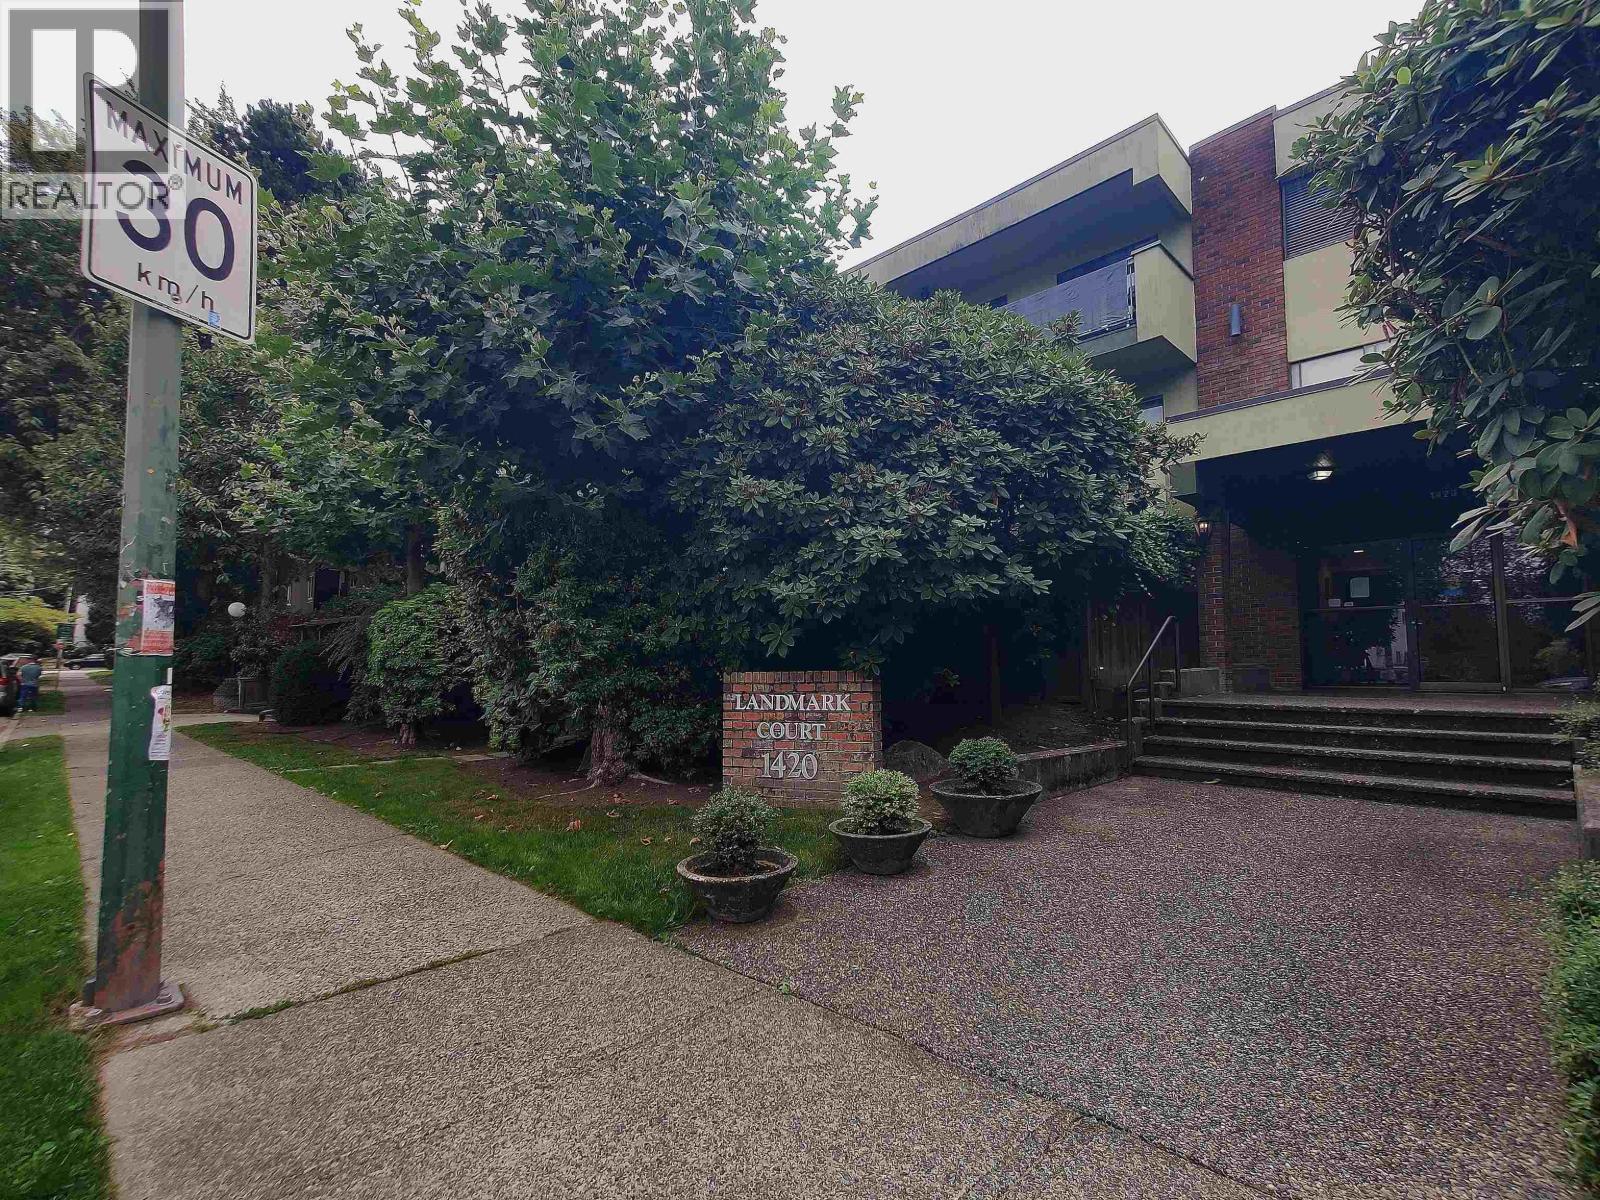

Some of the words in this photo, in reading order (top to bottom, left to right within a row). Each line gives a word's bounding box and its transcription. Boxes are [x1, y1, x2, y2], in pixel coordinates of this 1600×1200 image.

[107, 101, 243, 206] MAXIMUM
[116, 159, 235, 282] 30
[137, 262, 215, 310] km/h
[734, 694, 851, 711] LANDMARK
[756, 722, 826, 740] COURT
[761, 751, 818, 779] 1420
